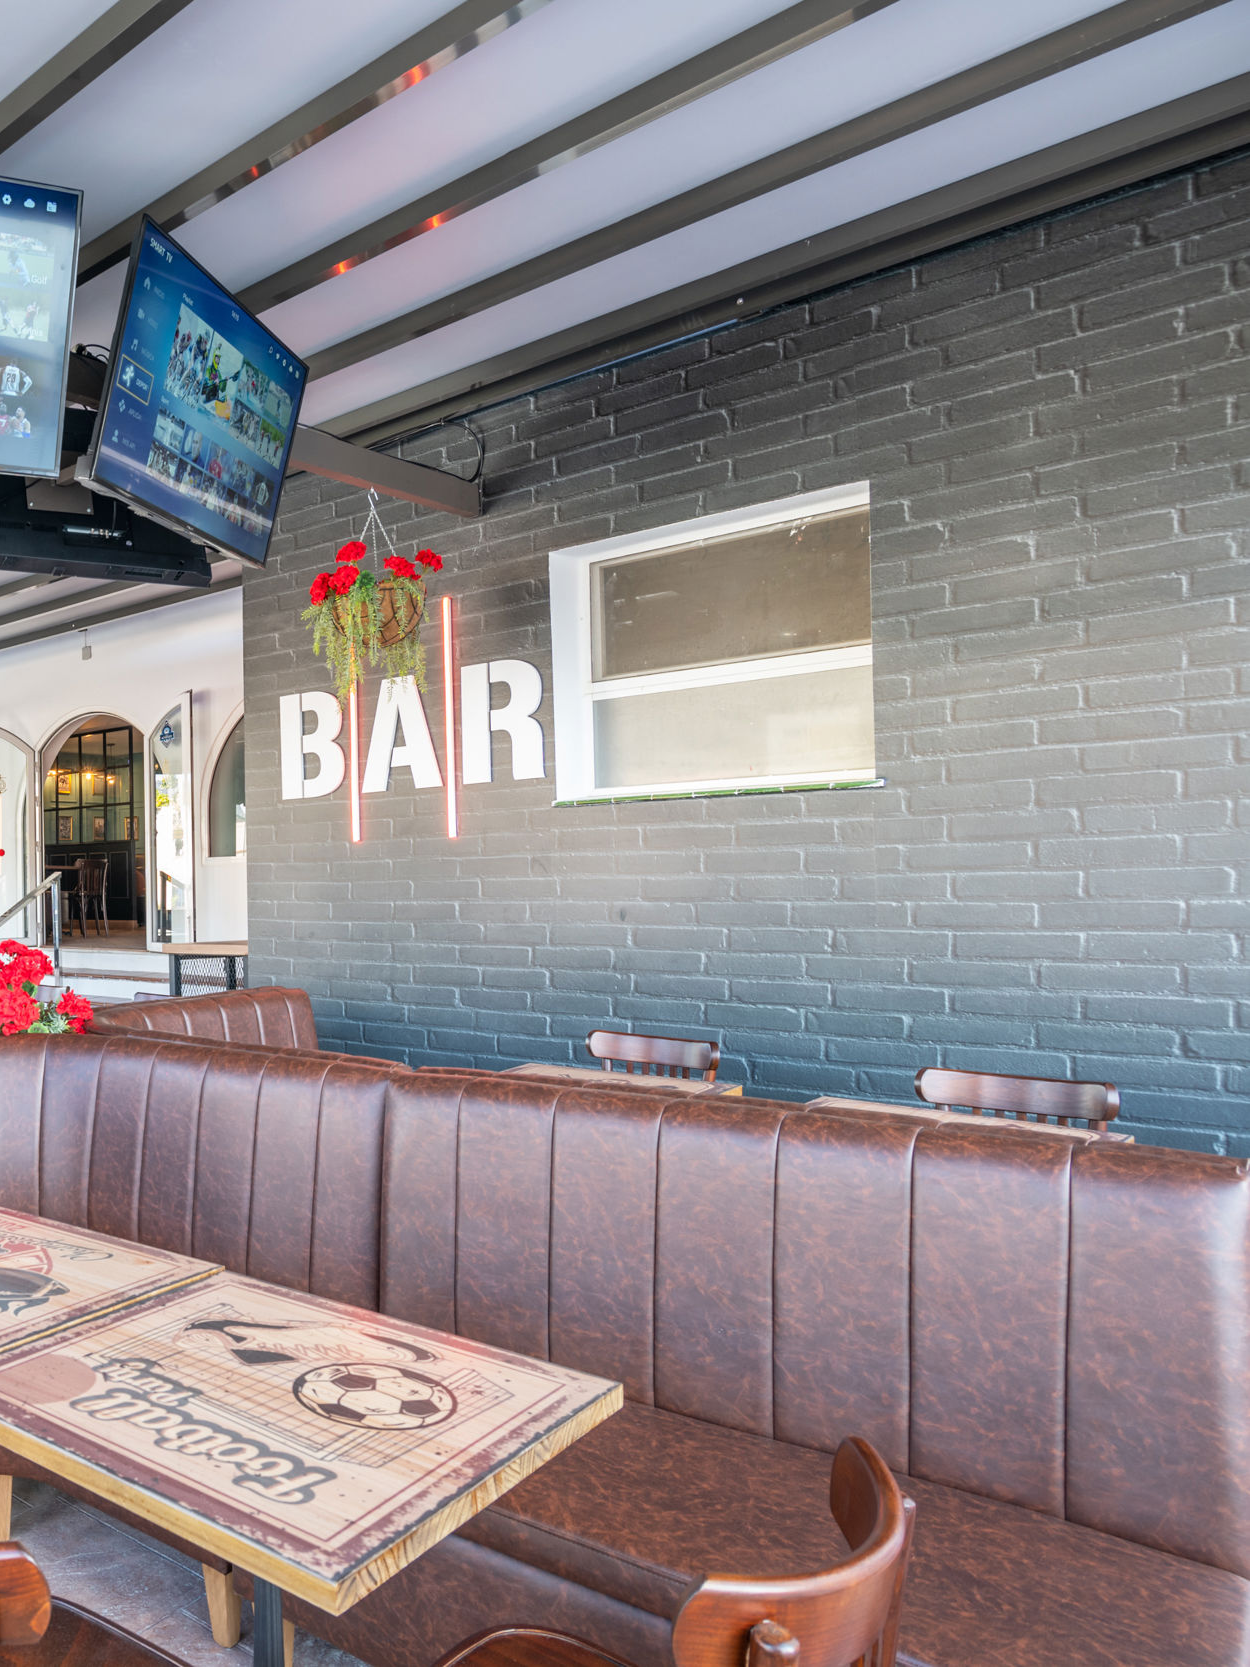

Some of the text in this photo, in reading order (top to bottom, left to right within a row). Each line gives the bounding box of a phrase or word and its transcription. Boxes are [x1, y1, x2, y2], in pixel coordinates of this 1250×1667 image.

[150, 237, 166, 257] SMART
[279, 658, 546, 800] BAR
[93, 1358, 204, 1407] Party
[70, 1388, 338, 1504] Football
